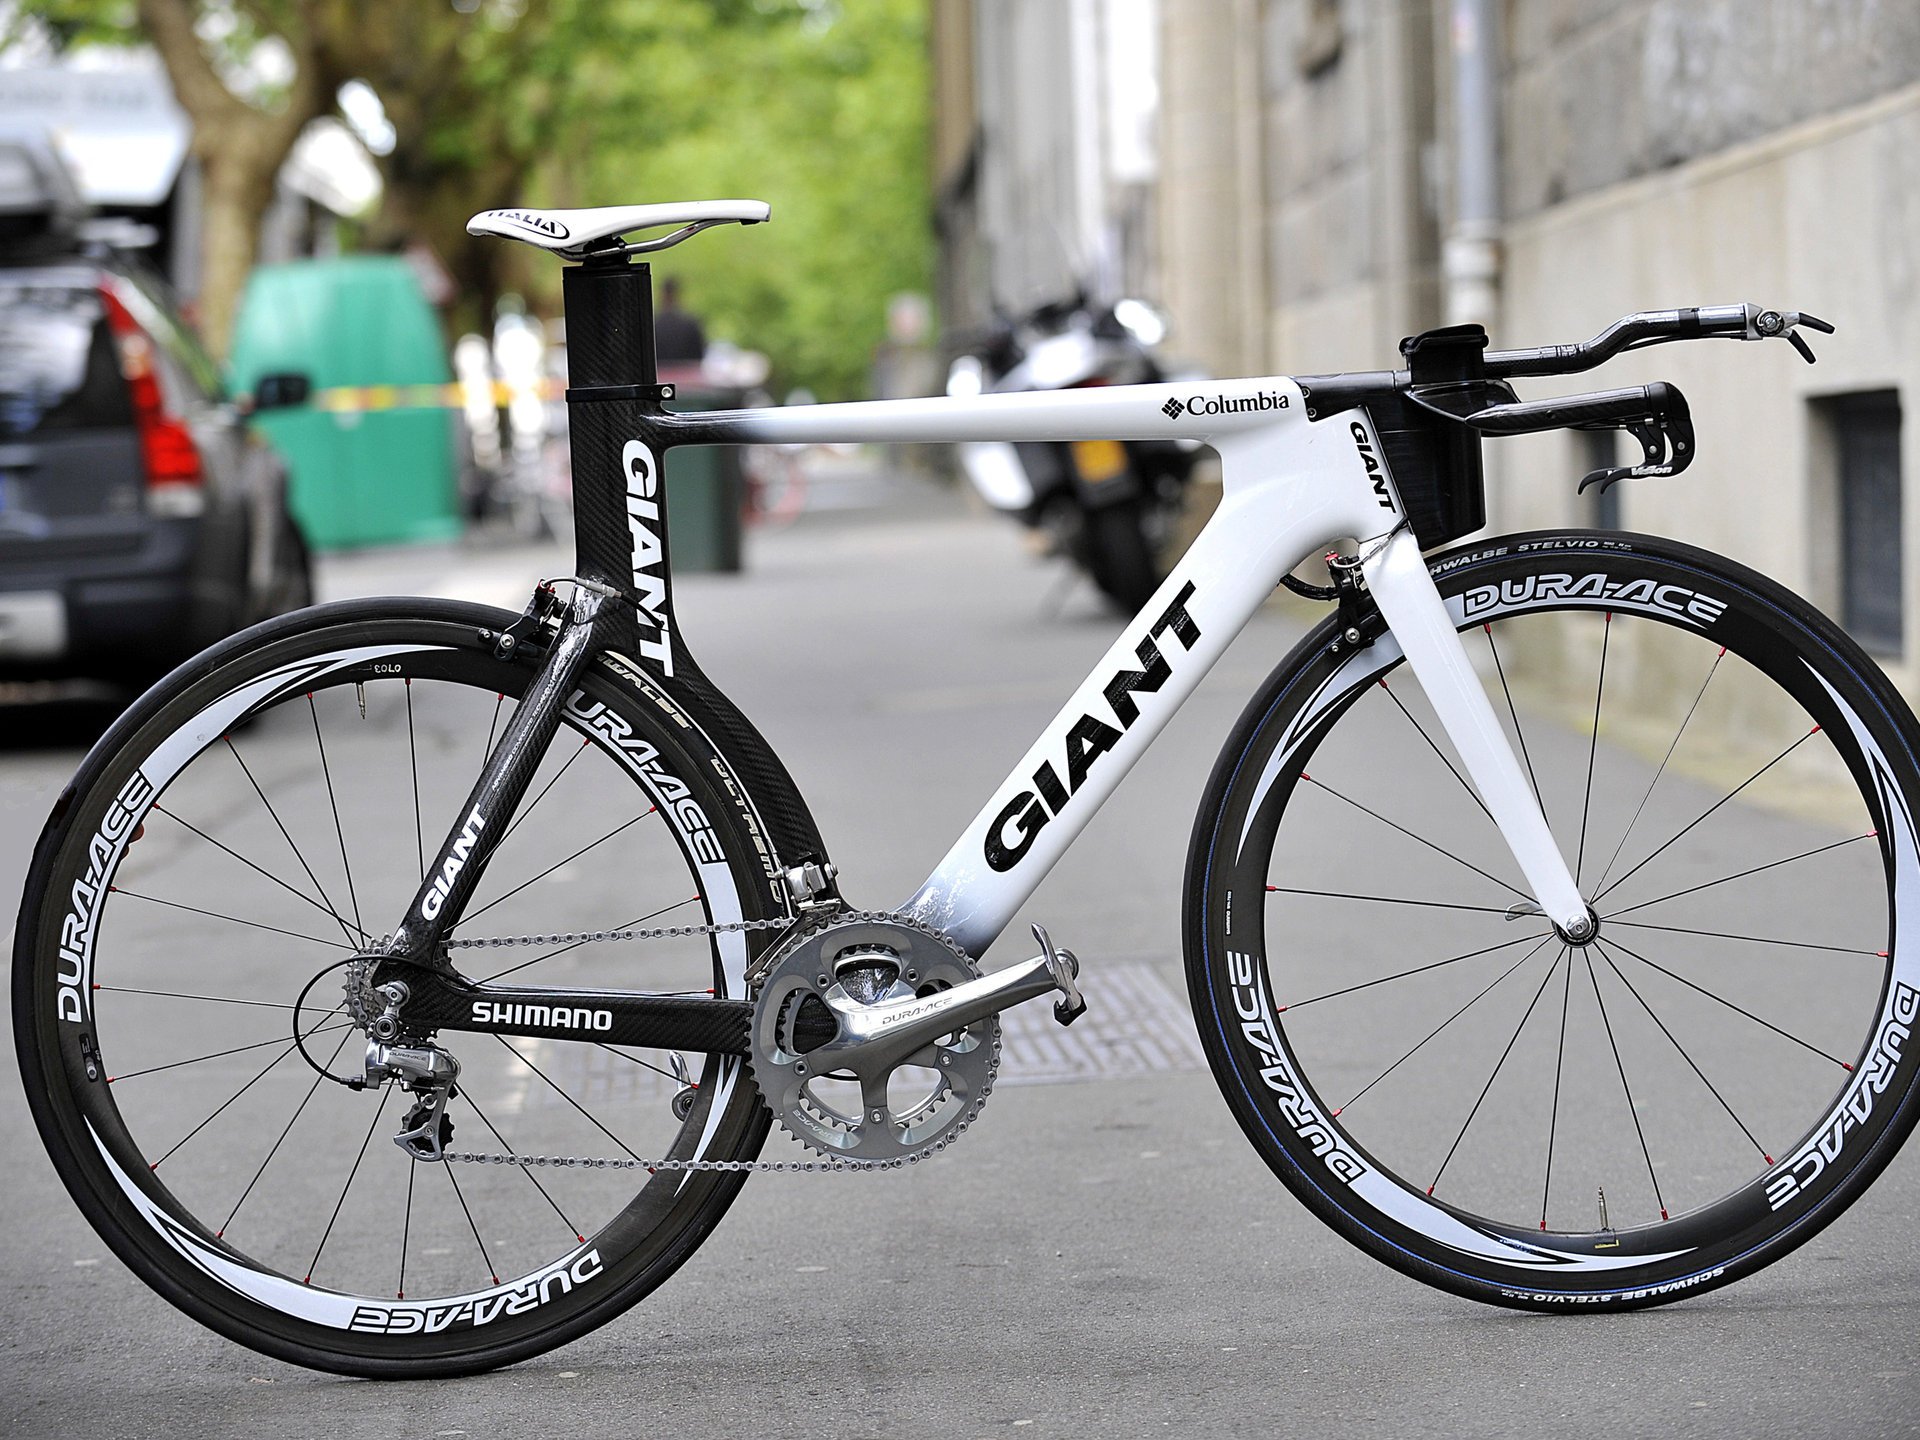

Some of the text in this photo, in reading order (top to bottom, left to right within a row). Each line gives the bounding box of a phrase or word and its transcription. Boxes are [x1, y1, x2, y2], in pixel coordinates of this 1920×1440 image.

[1187, 391, 1290, 416] Columbia
[1350, 421, 1396, 514] GIANT
[1631, 466, 1673, 476] Vision
[622, 439, 674, 678] GIANT
[1429, 547, 1508, 576] HWALBE
[1518, 540, 1599, 552] STELVIO
[1466, 573, 1728, 624] DURA-ACE
[599, 653, 692, 730] WALBE
[984, 579, 1201, 873] GIANT
[566, 690, 726, 862] URA-ACE
[57, 771, 154, 1022] DURA-ACE
[421, 803, 486, 921] GIANT
[472, 1002, 613, 1031] SHIMANO
[882, 997, 953, 1025] DURA-ACE
[1227, 951, 1368, 1184] DURA-ACE
[1765, 981, 1920, 1211] DURA-ACE
[792, 1109, 840, 1140] URA-ACE
[350, 1248, 603, 1334] DURA-ACE
[1533, 1294, 1611, 1303] STELVIO
[1621, 1266, 1725, 1300] SCHWALBE
